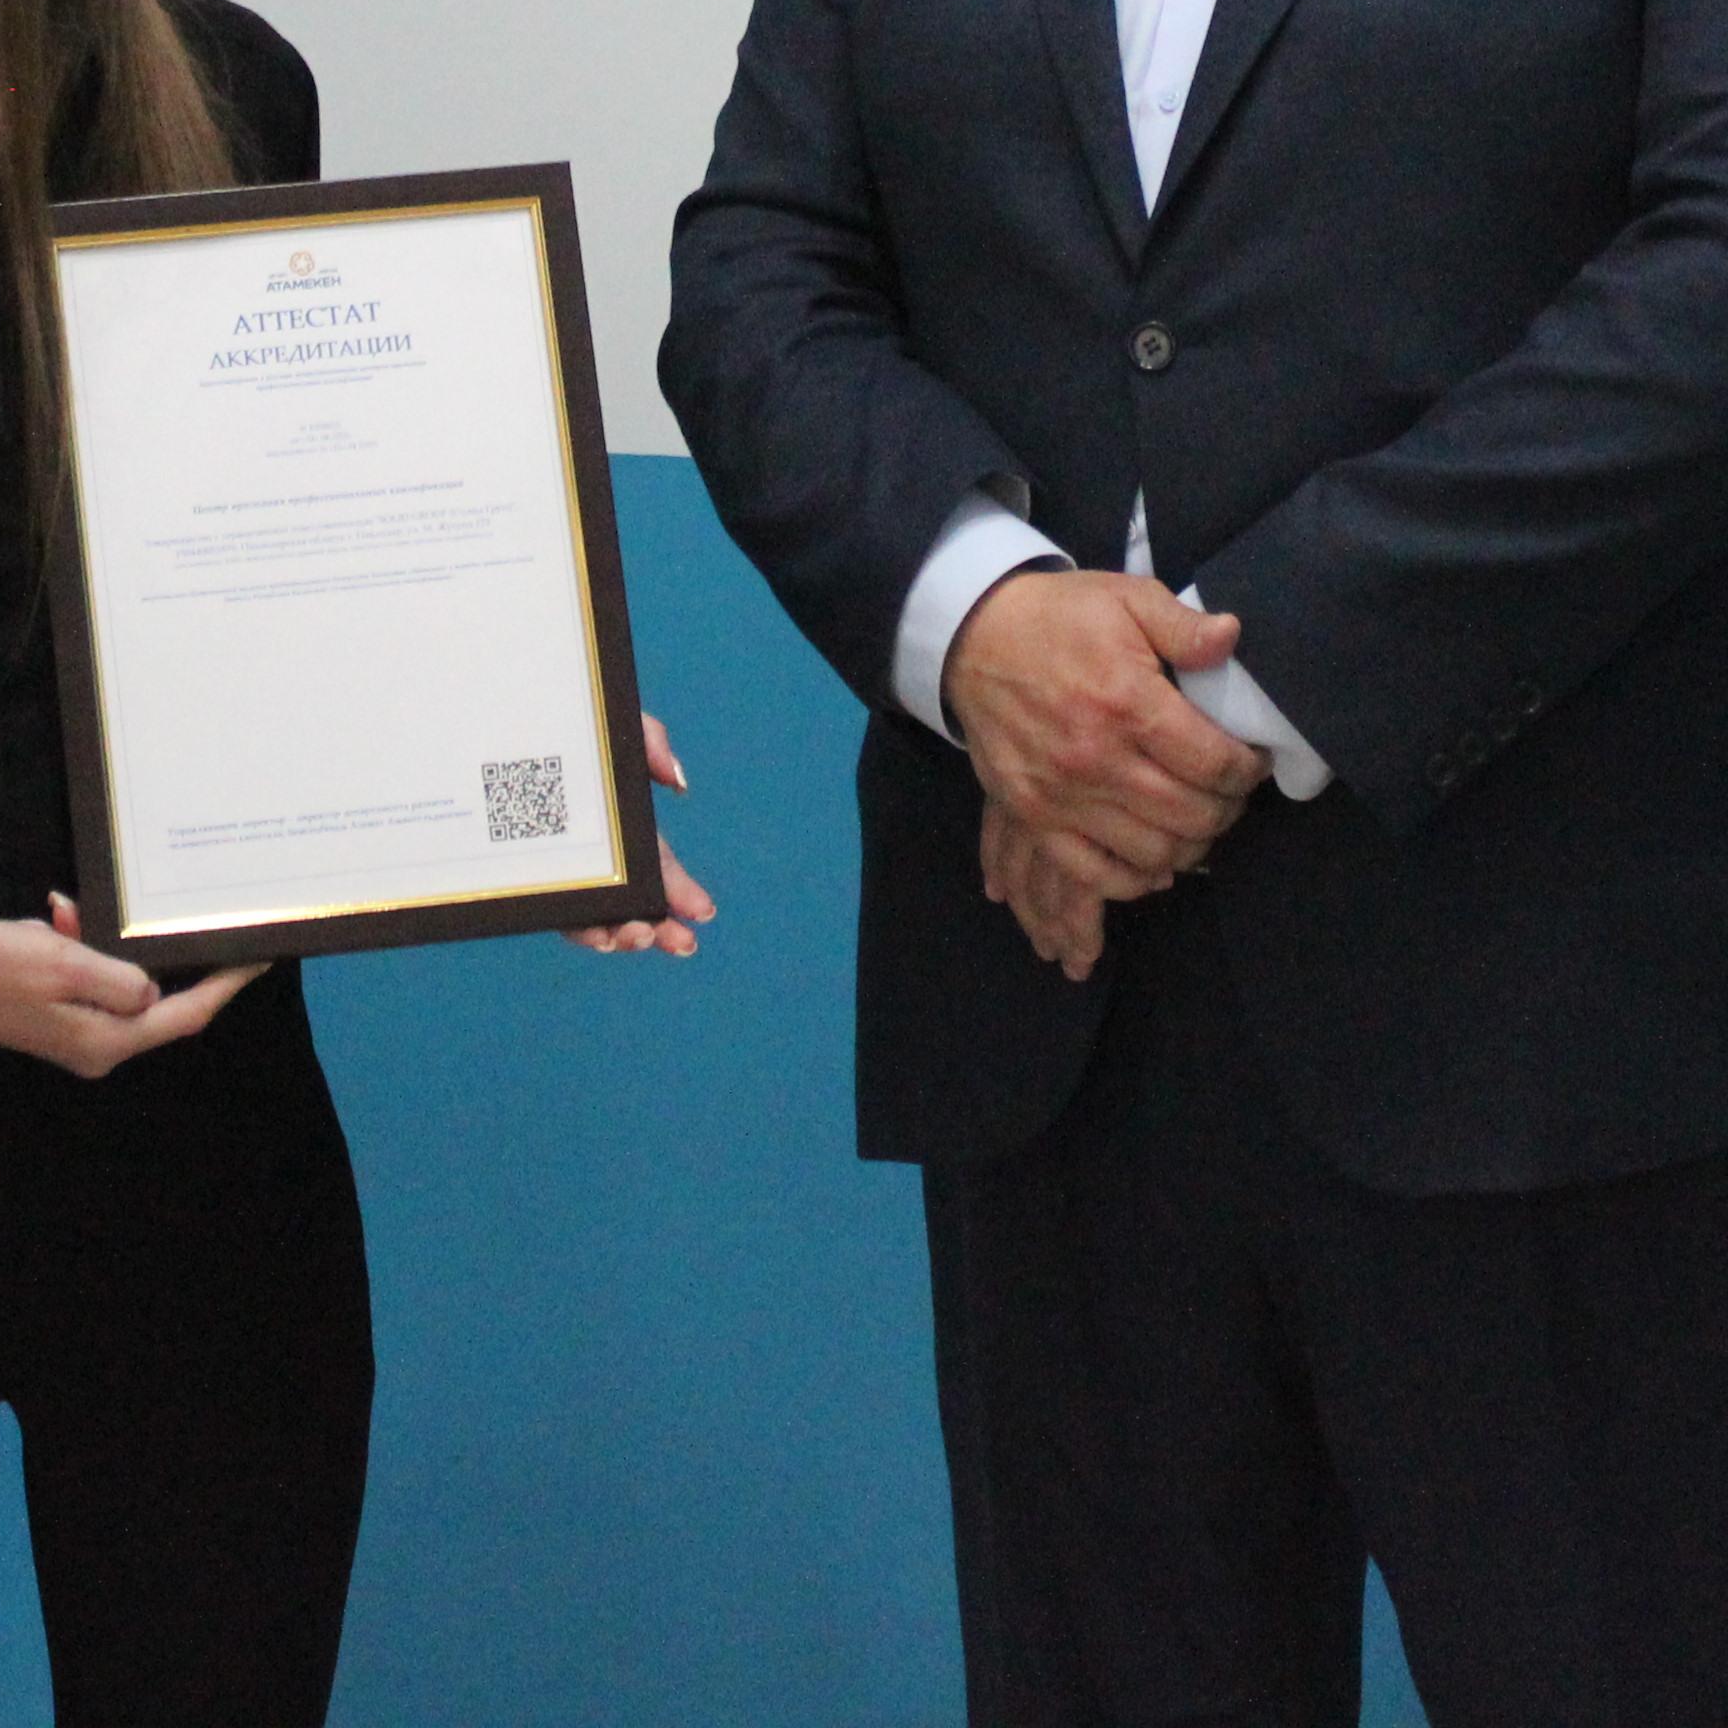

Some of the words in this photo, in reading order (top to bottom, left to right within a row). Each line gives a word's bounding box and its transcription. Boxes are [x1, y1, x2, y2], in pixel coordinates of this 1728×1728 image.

[266, 275, 342, 294] АТАМЕКЕН
[232, 300, 382, 336] АТТЕСТАТ
[208, 333, 413, 371] АККРЕДИТАЦИИ
